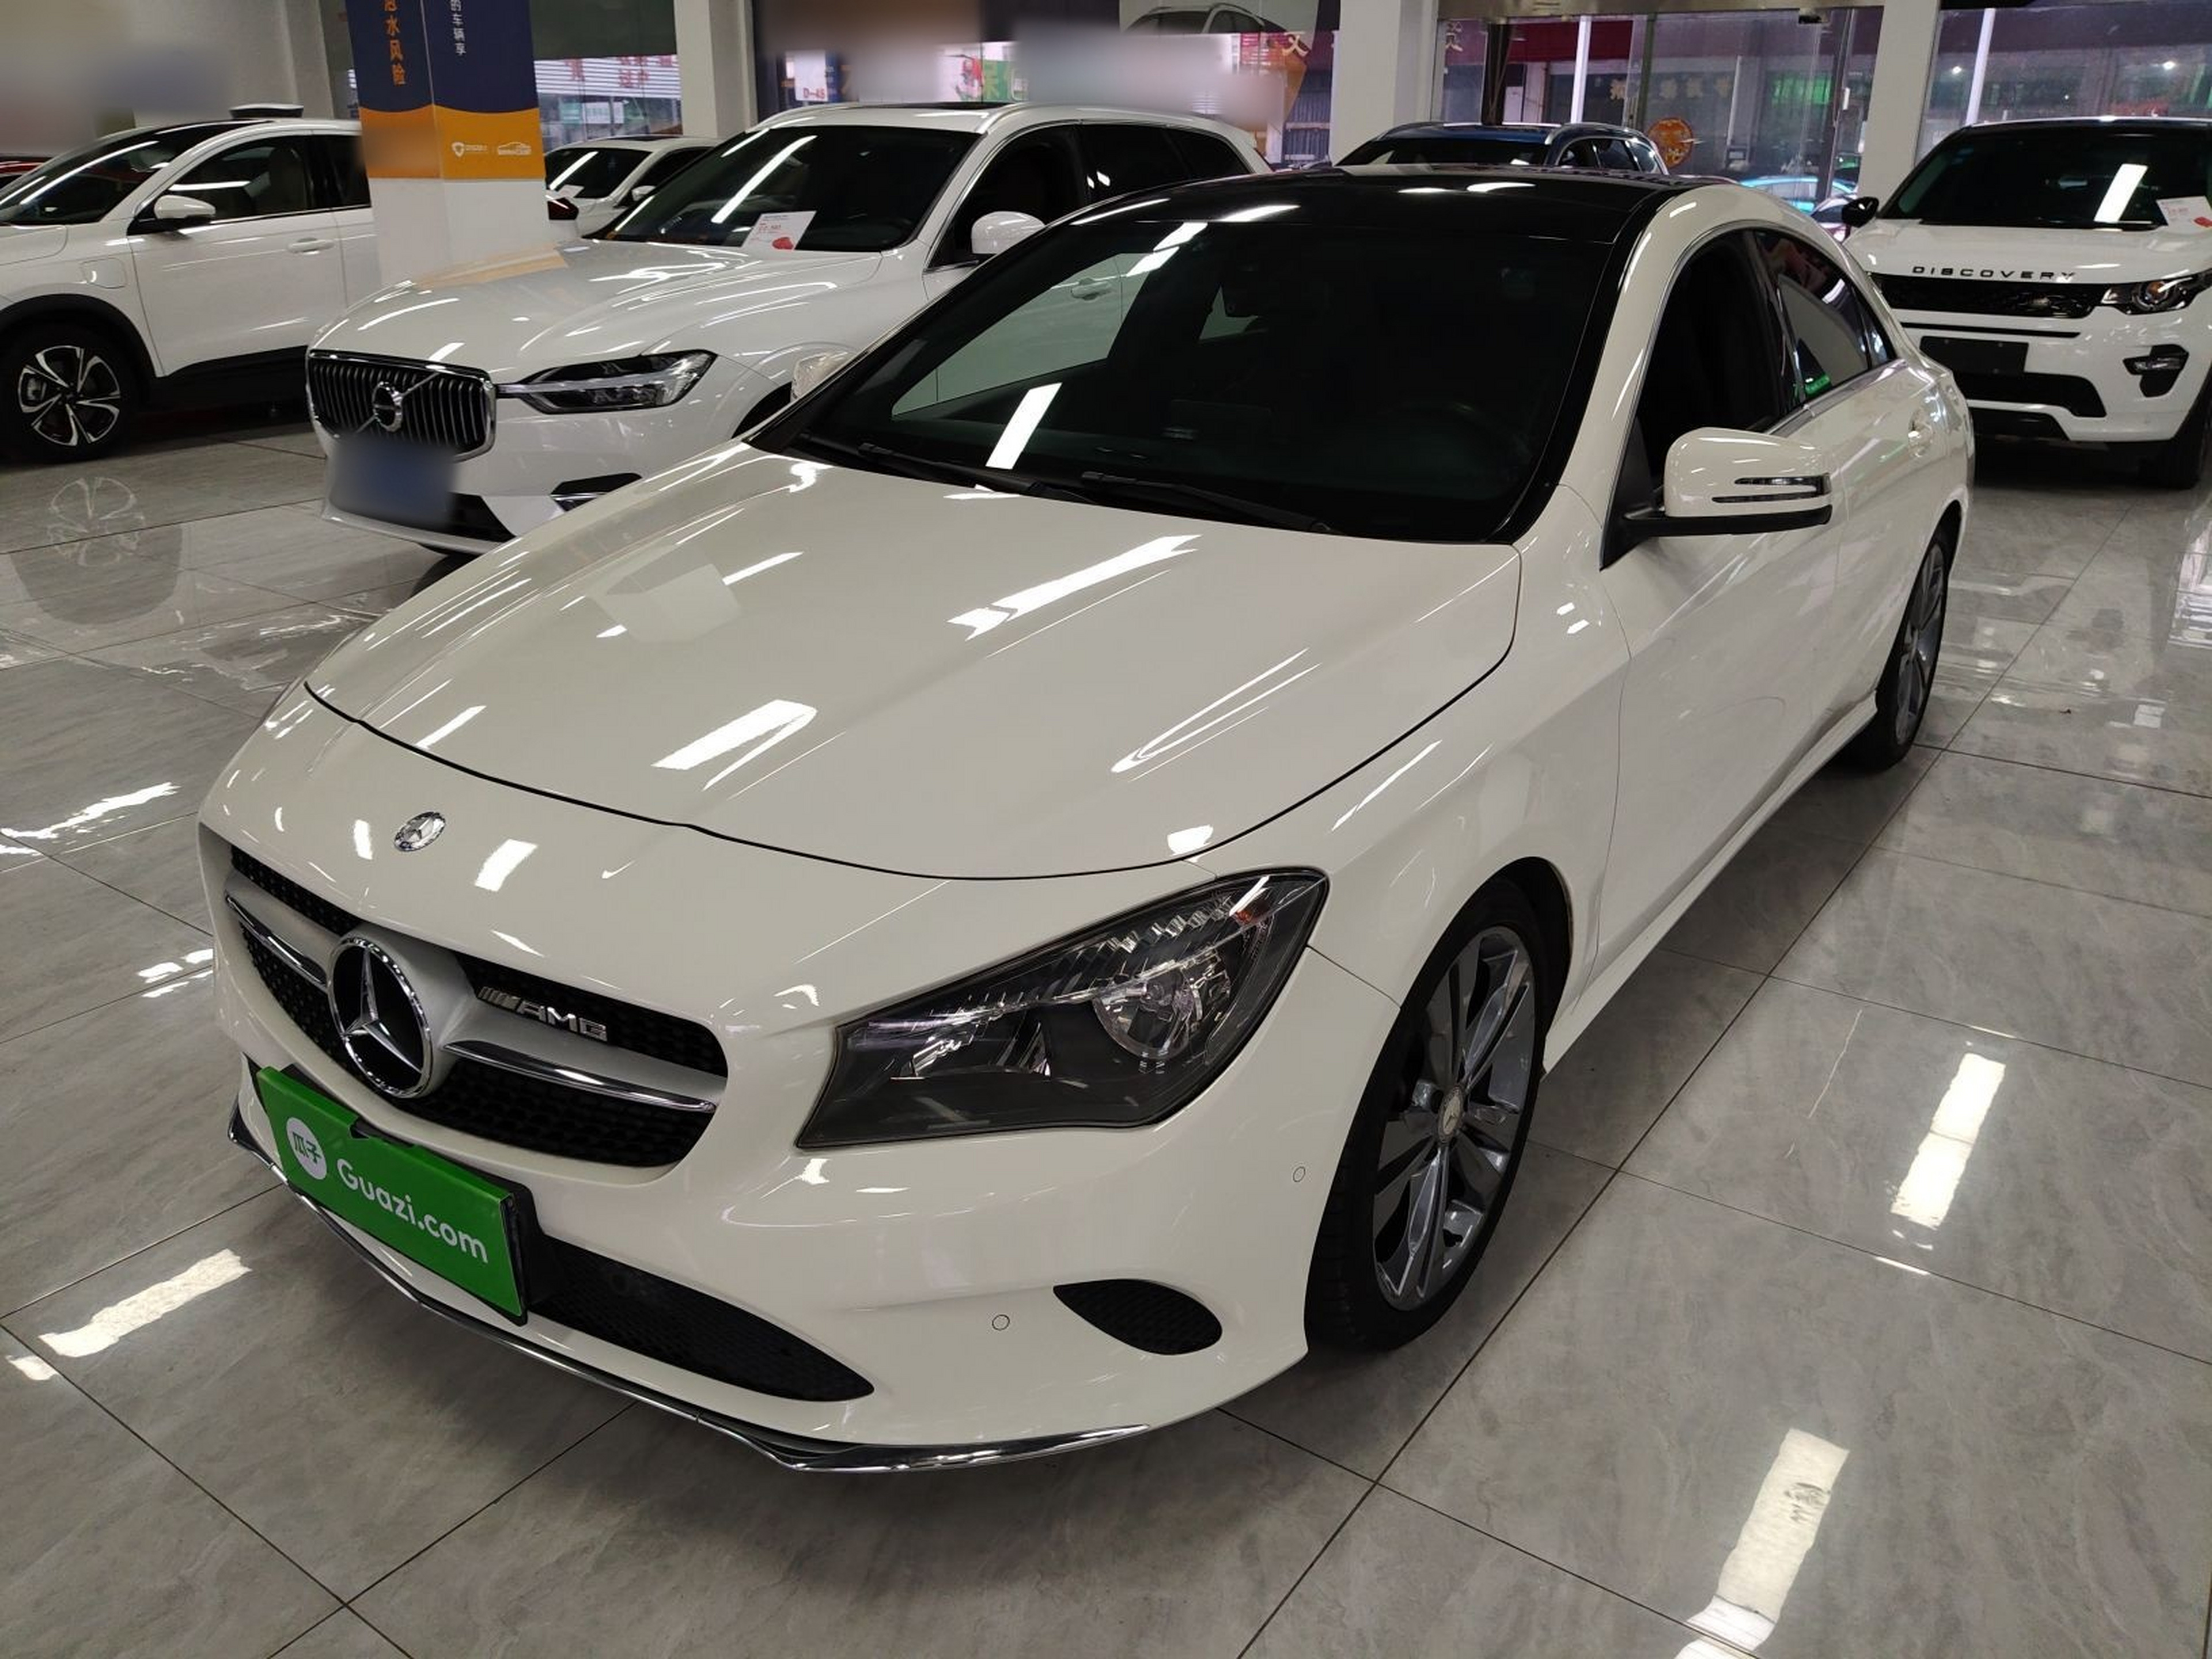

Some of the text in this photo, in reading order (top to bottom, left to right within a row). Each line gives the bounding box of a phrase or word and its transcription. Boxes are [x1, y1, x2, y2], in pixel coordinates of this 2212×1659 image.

[1912, 266, 2075, 280] DISCOVERY
[291, 1131, 322, 1164] 瓜子
[336, 1158, 488, 1264] Guazi.com
